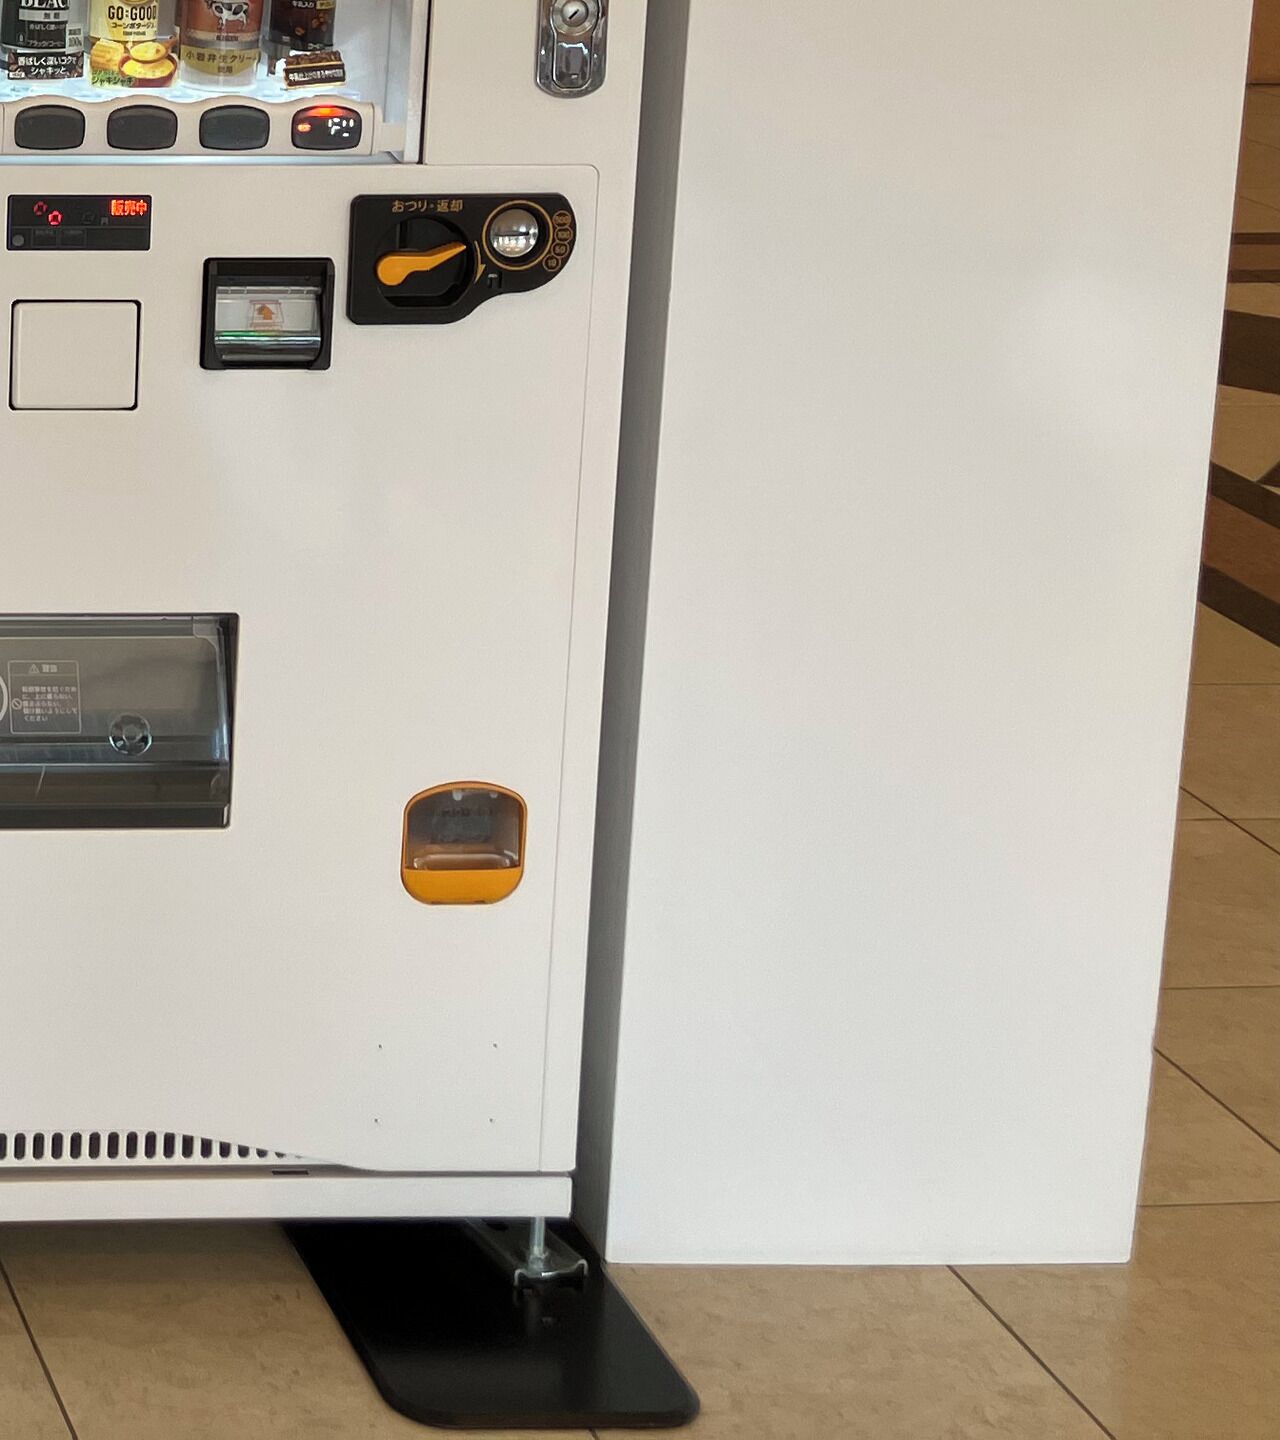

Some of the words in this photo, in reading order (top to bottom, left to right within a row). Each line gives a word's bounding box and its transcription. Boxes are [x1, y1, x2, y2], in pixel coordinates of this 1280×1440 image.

[110, 199, 148, 216] 販売中
[391, 199, 464, 213] おつり・返却
